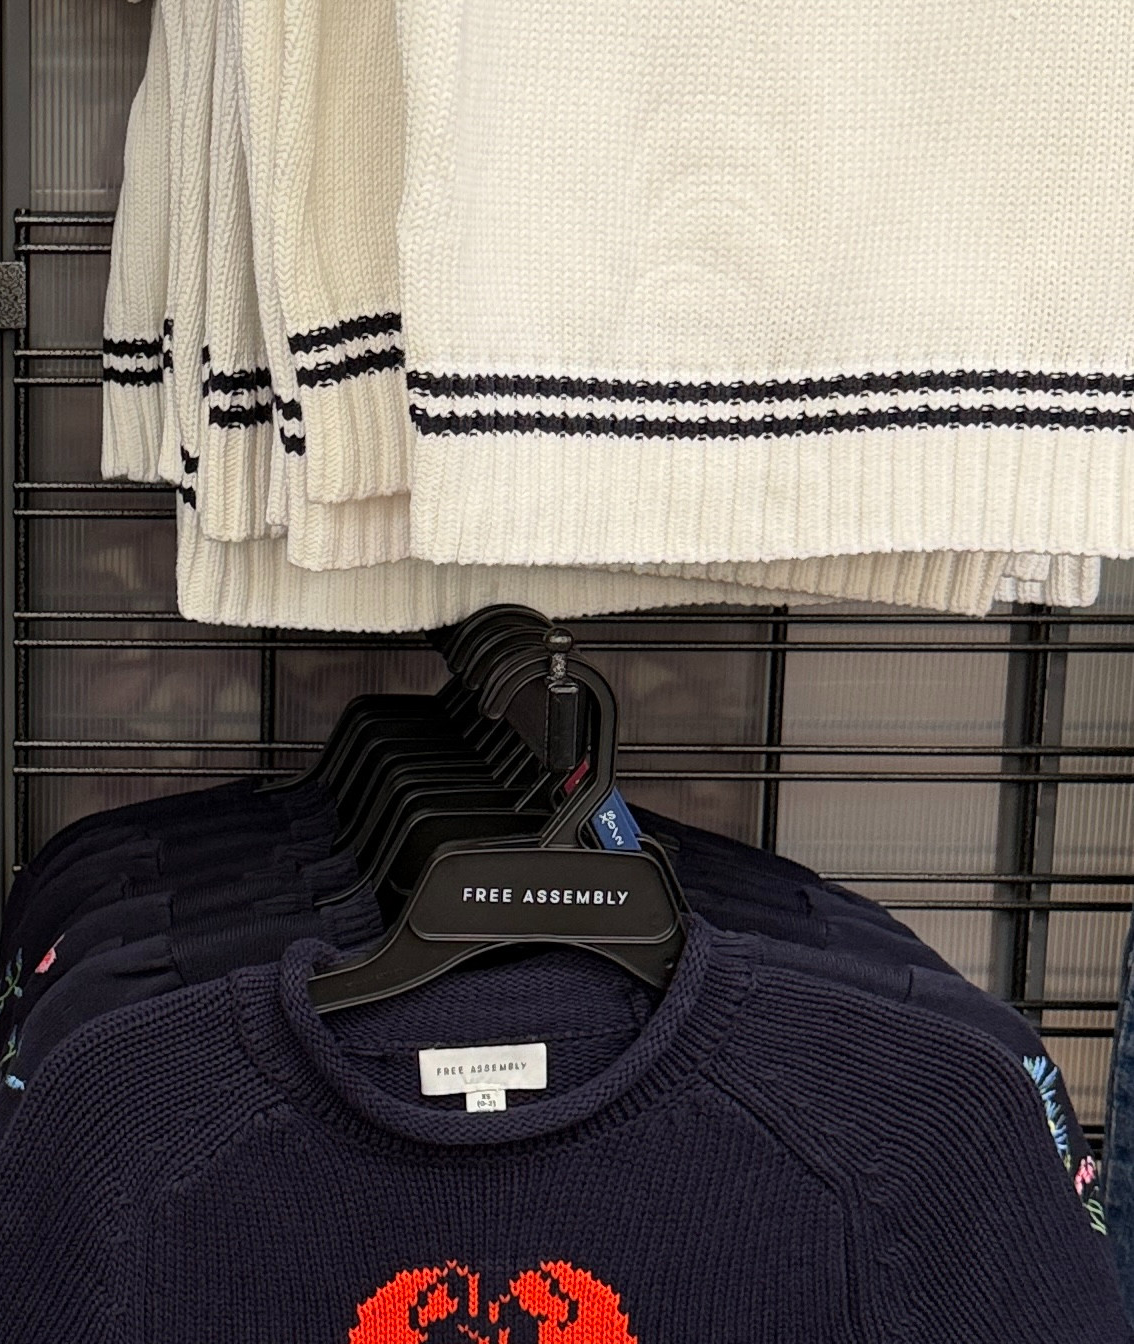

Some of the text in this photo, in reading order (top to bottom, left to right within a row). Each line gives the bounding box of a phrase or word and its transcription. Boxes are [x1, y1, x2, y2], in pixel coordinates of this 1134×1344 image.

[598, 810, 617, 824] XS
[462, 887, 629, 905] FREE ASSEMBLY
[436, 1061, 527, 1076] FREE ASSEMBLY
